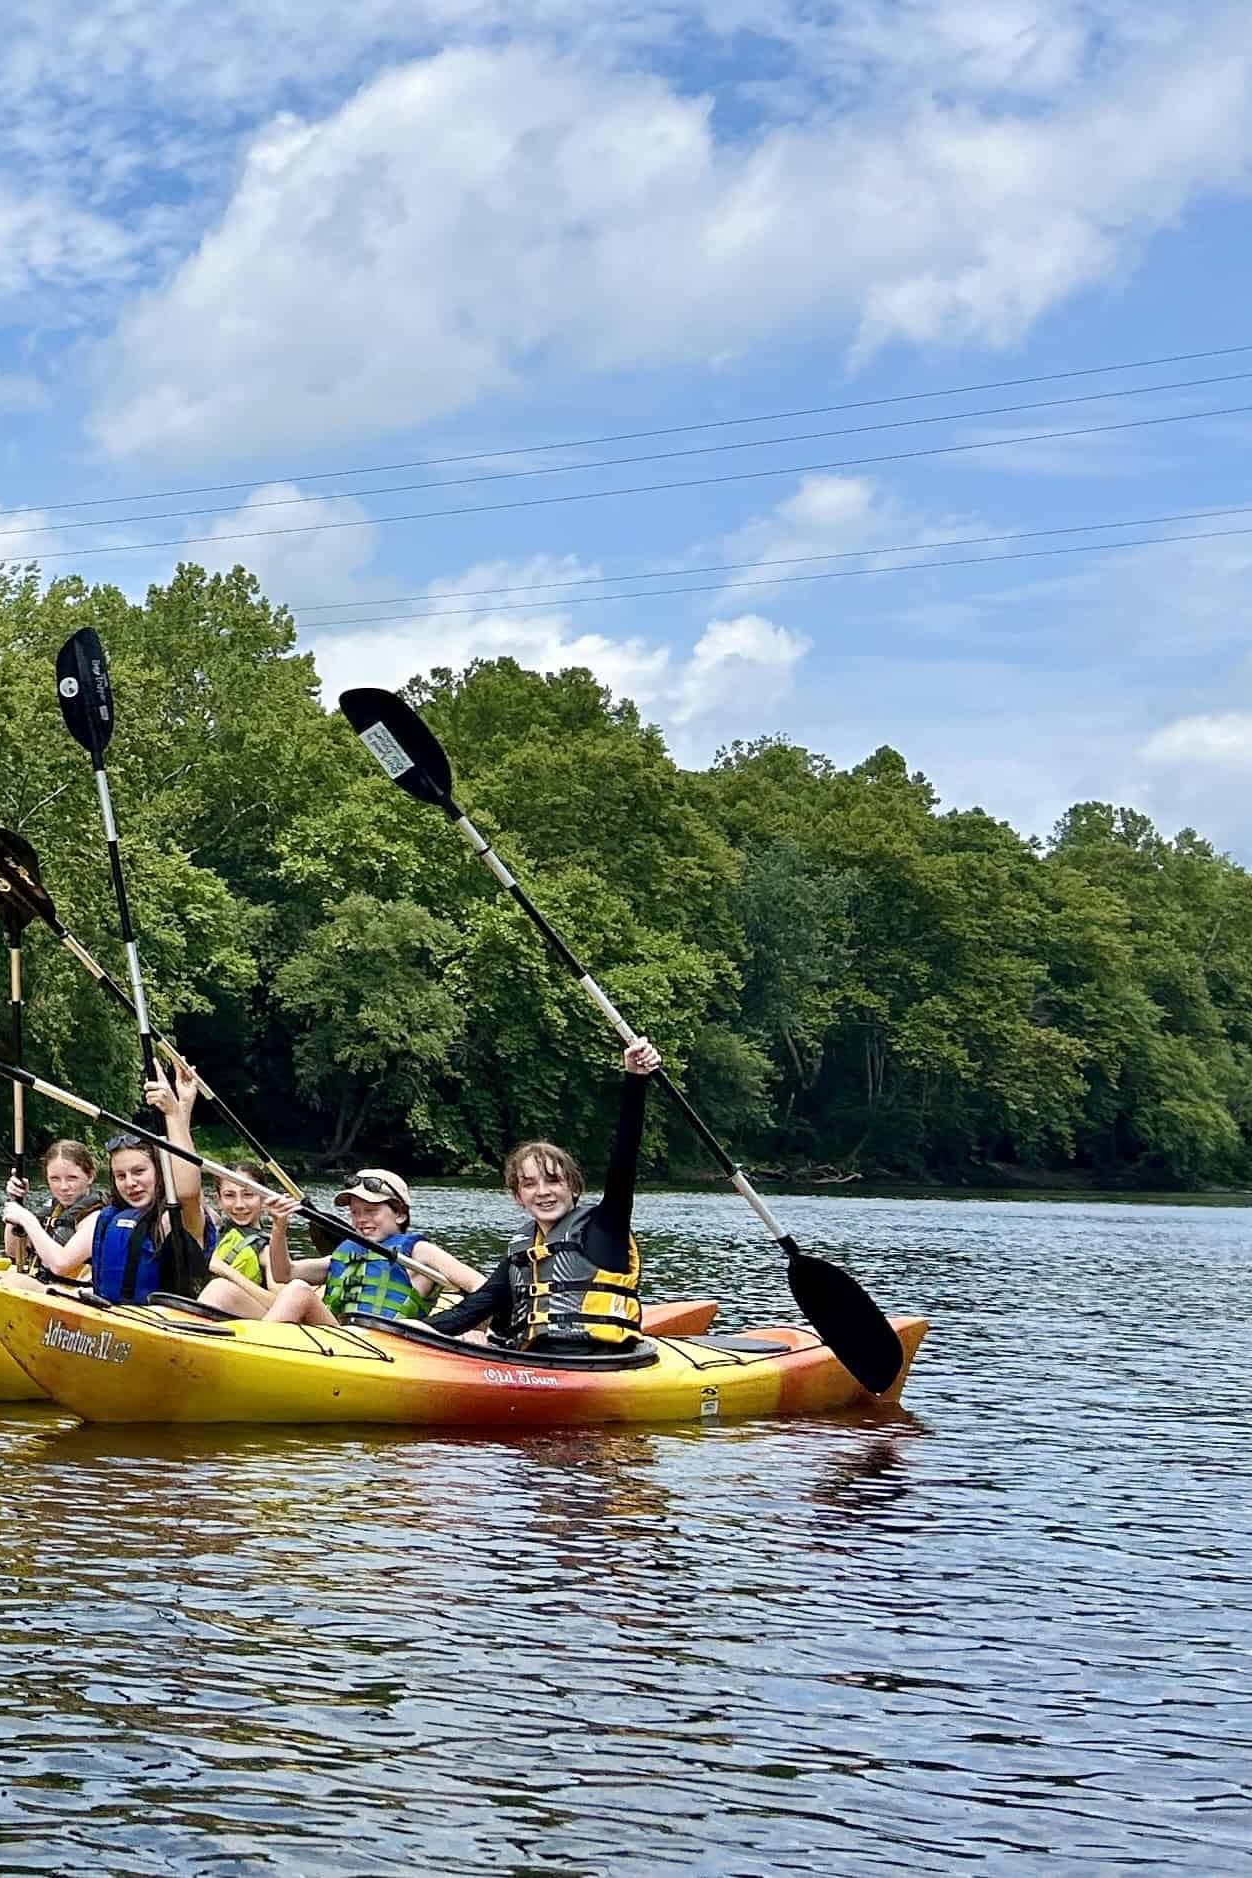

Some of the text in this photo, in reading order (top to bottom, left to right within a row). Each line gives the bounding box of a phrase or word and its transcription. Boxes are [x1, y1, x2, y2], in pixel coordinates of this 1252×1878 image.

[42, 1317, 96, 1355] Adventure
[483, 1368, 560, 1386] Old Town
